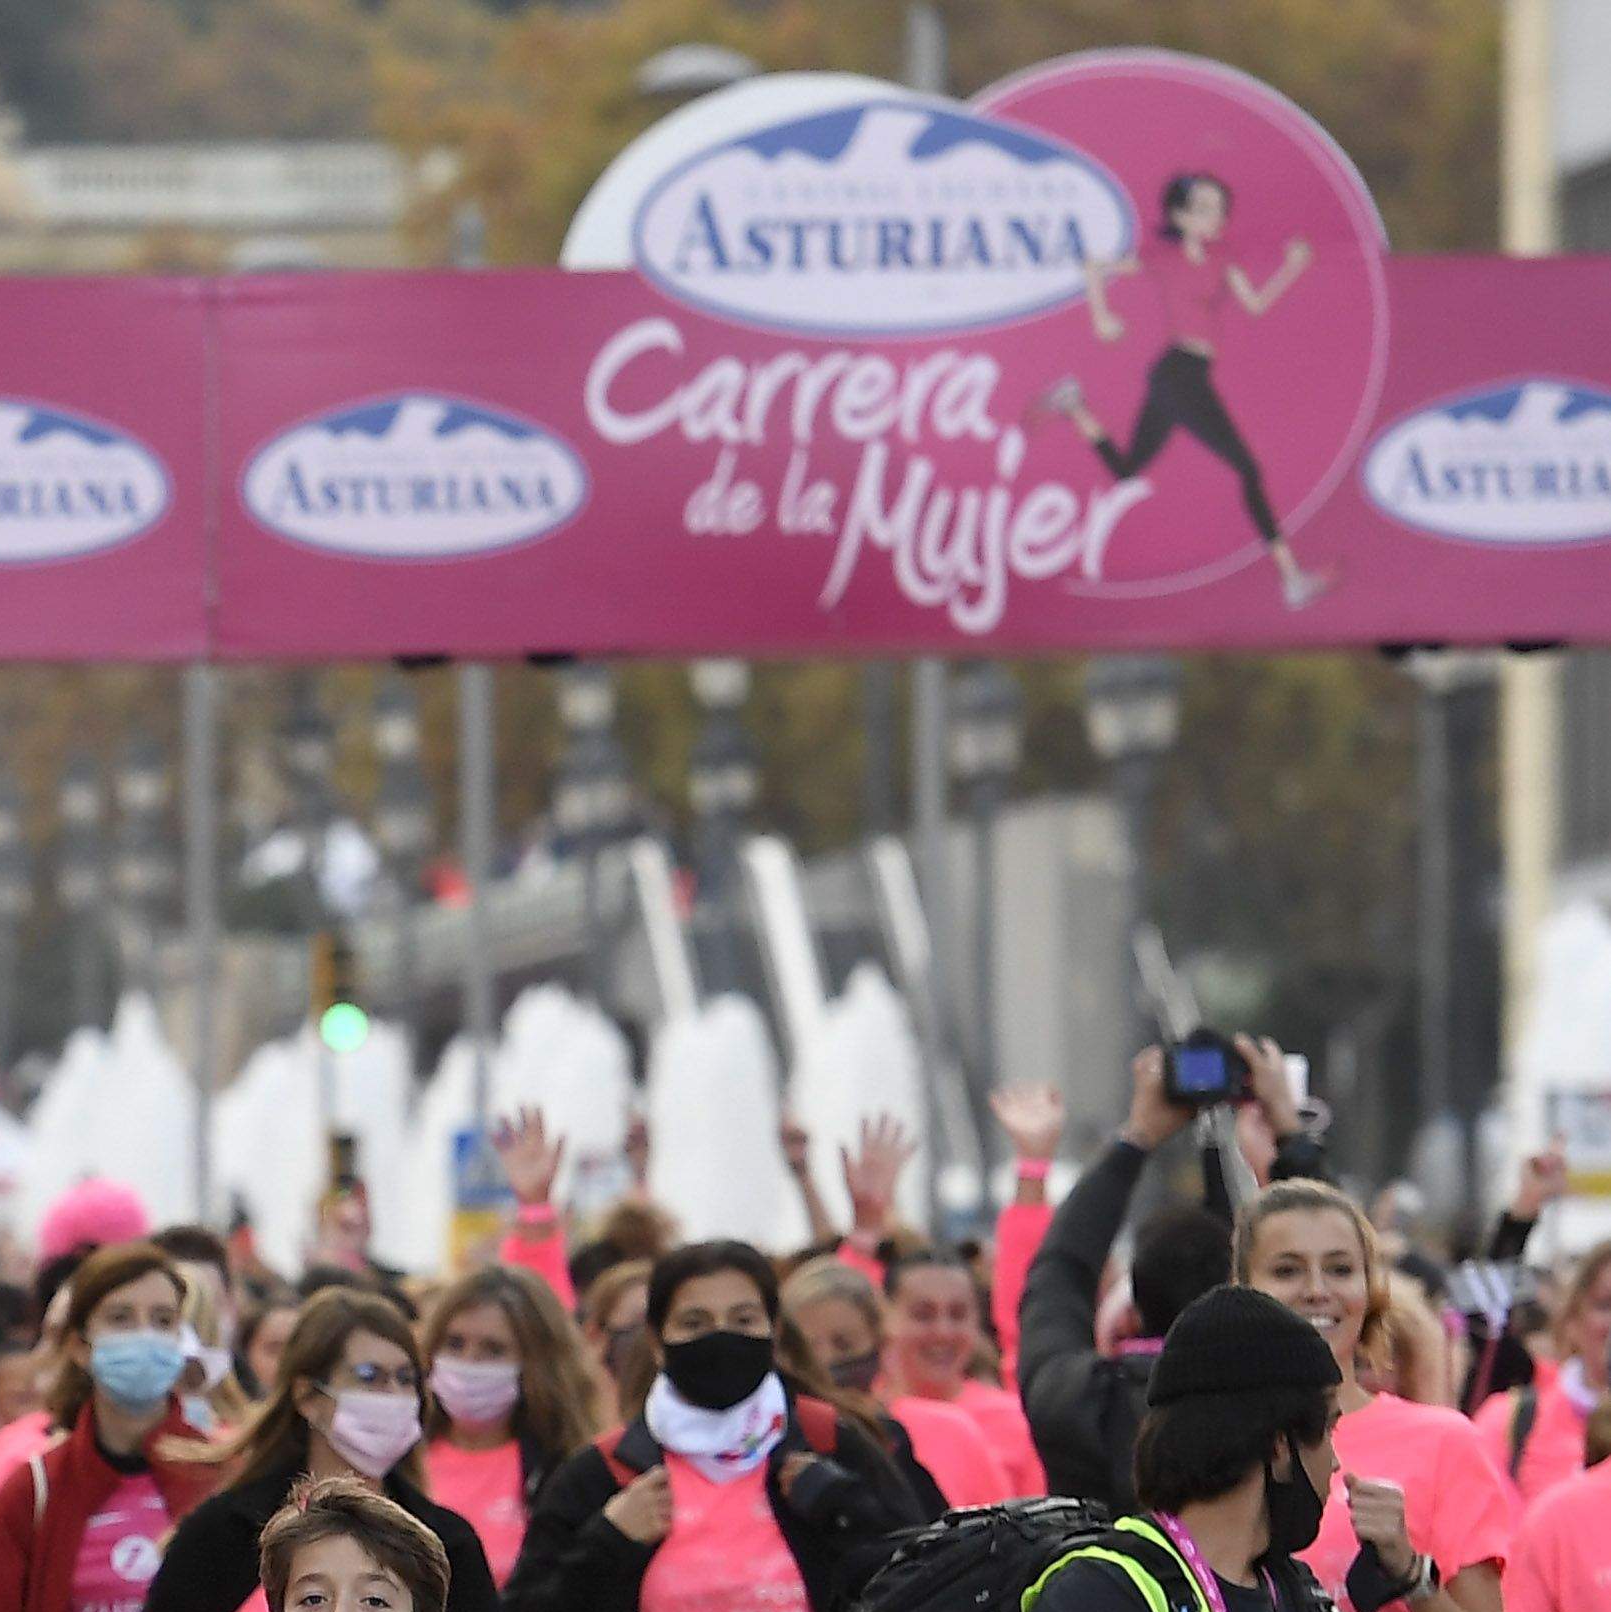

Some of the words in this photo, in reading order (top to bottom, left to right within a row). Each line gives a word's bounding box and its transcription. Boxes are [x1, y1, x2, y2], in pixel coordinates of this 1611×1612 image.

[675, 194, 1087, 274] ASTURIANA
[585, 318, 1007, 440] Carrera
[269, 458, 553, 516] ASTURIANA
[1389, 444, 1611, 501] ASTURIA
[685, 455, 766, 535] de
[778, 453, 837, 534] la
[820, 441, 1155, 636] Mujer
